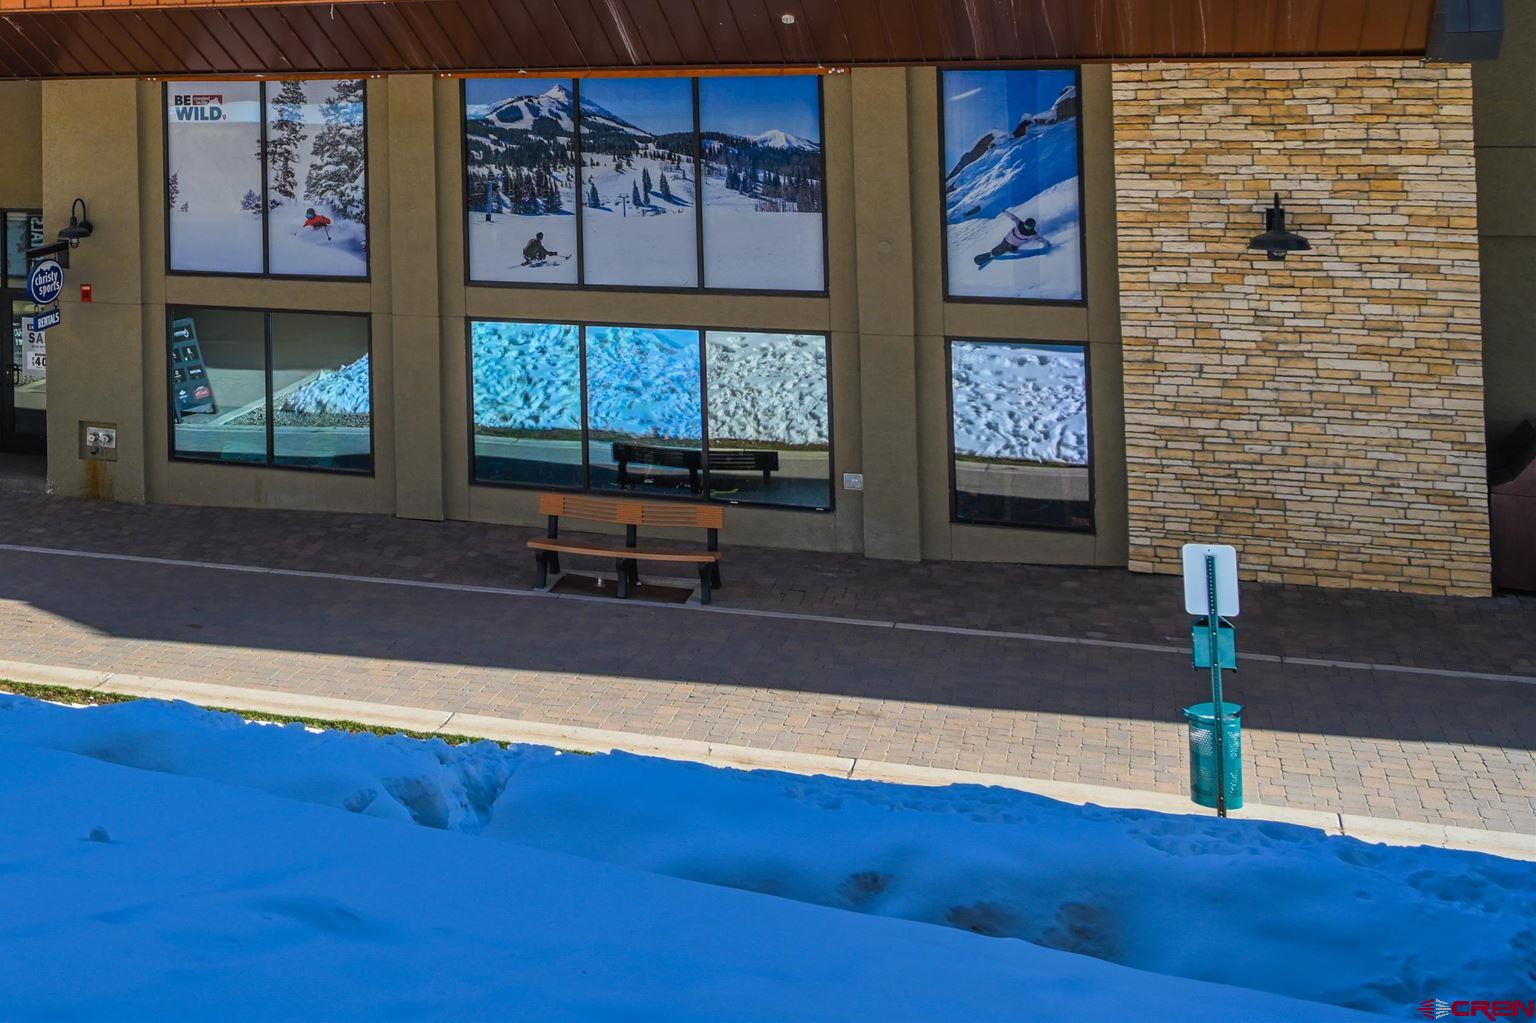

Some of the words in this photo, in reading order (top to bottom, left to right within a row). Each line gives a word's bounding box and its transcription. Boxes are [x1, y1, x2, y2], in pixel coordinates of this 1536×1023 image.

[175, 95, 191, 106] BE
[35, 271, 58, 286] christy
[38, 281, 60, 297] sports
[37, 312, 60, 329] RENTALS
